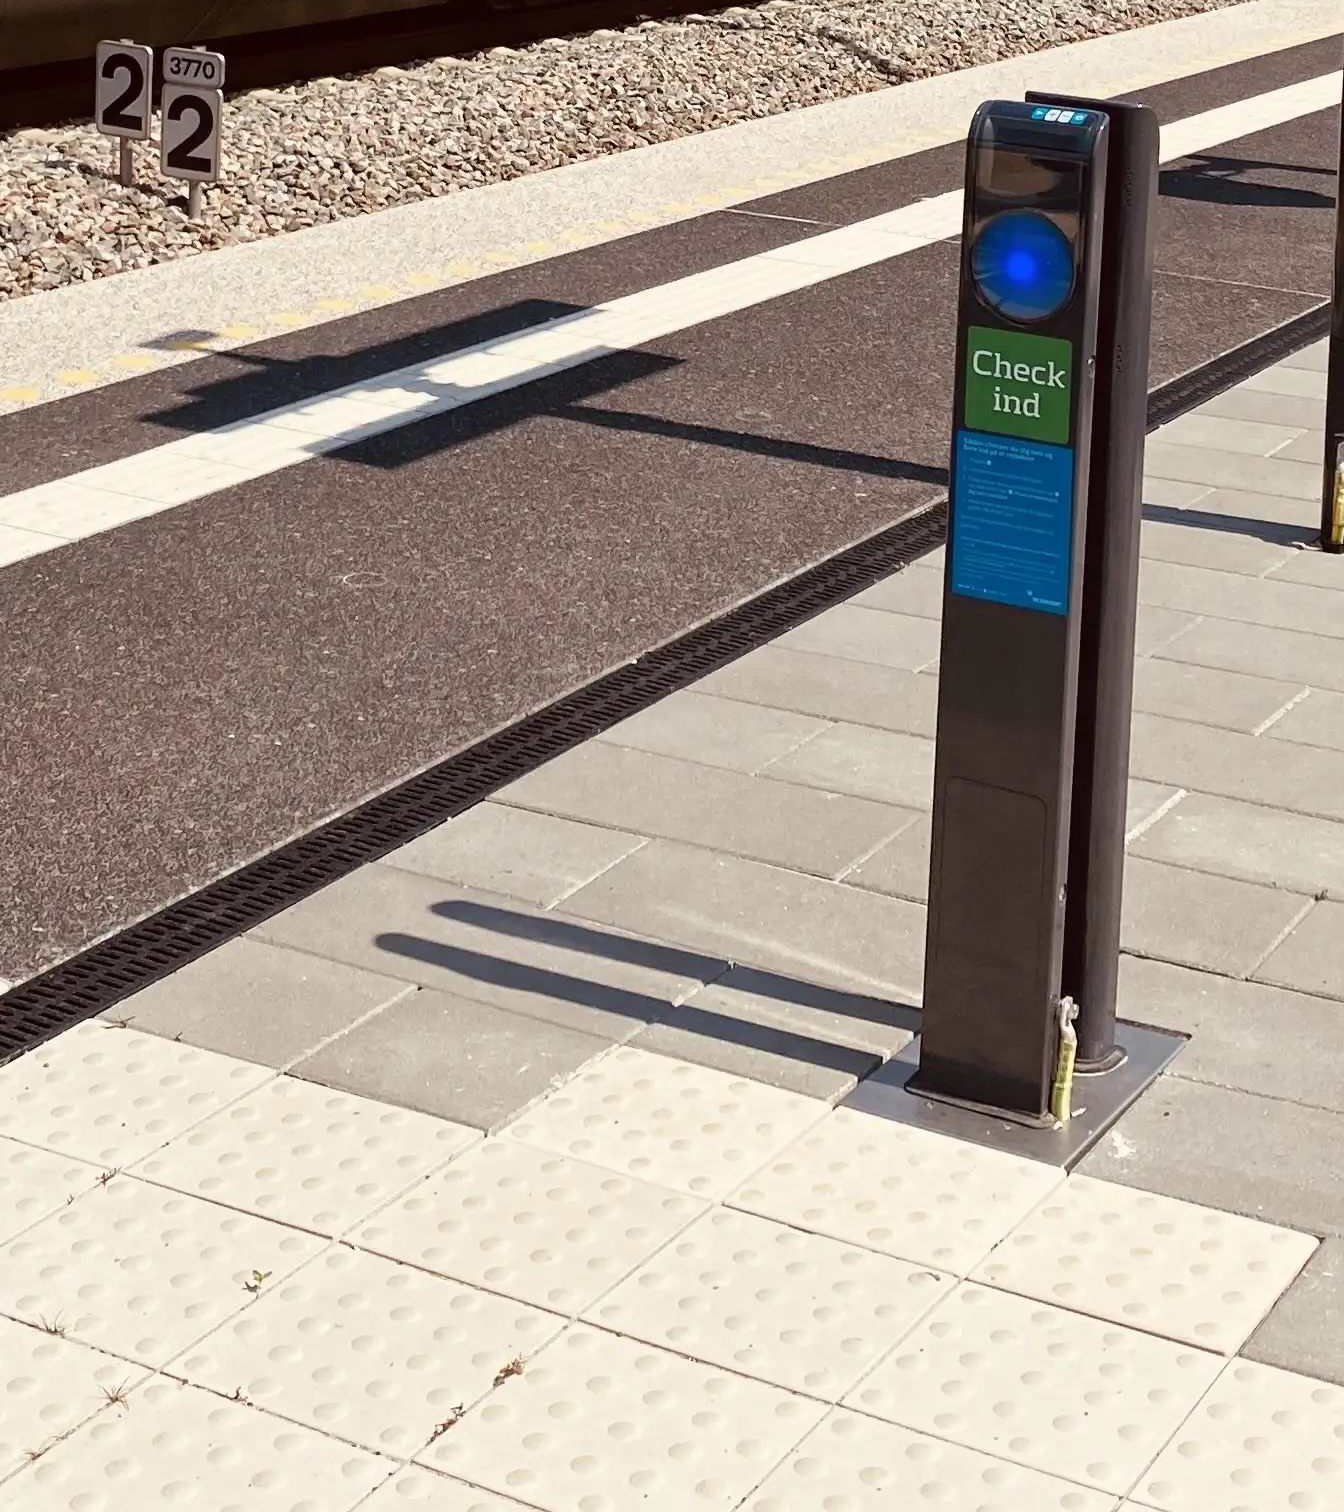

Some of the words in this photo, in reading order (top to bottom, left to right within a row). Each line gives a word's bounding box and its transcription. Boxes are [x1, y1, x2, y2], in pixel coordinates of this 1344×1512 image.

[170, 56, 215, 79] 3770
[102, 53, 144, 131] 2
[168, 94, 213, 173] 2
[973, 350, 1066, 388] Check
[993, 386, 1040, 418] ind
